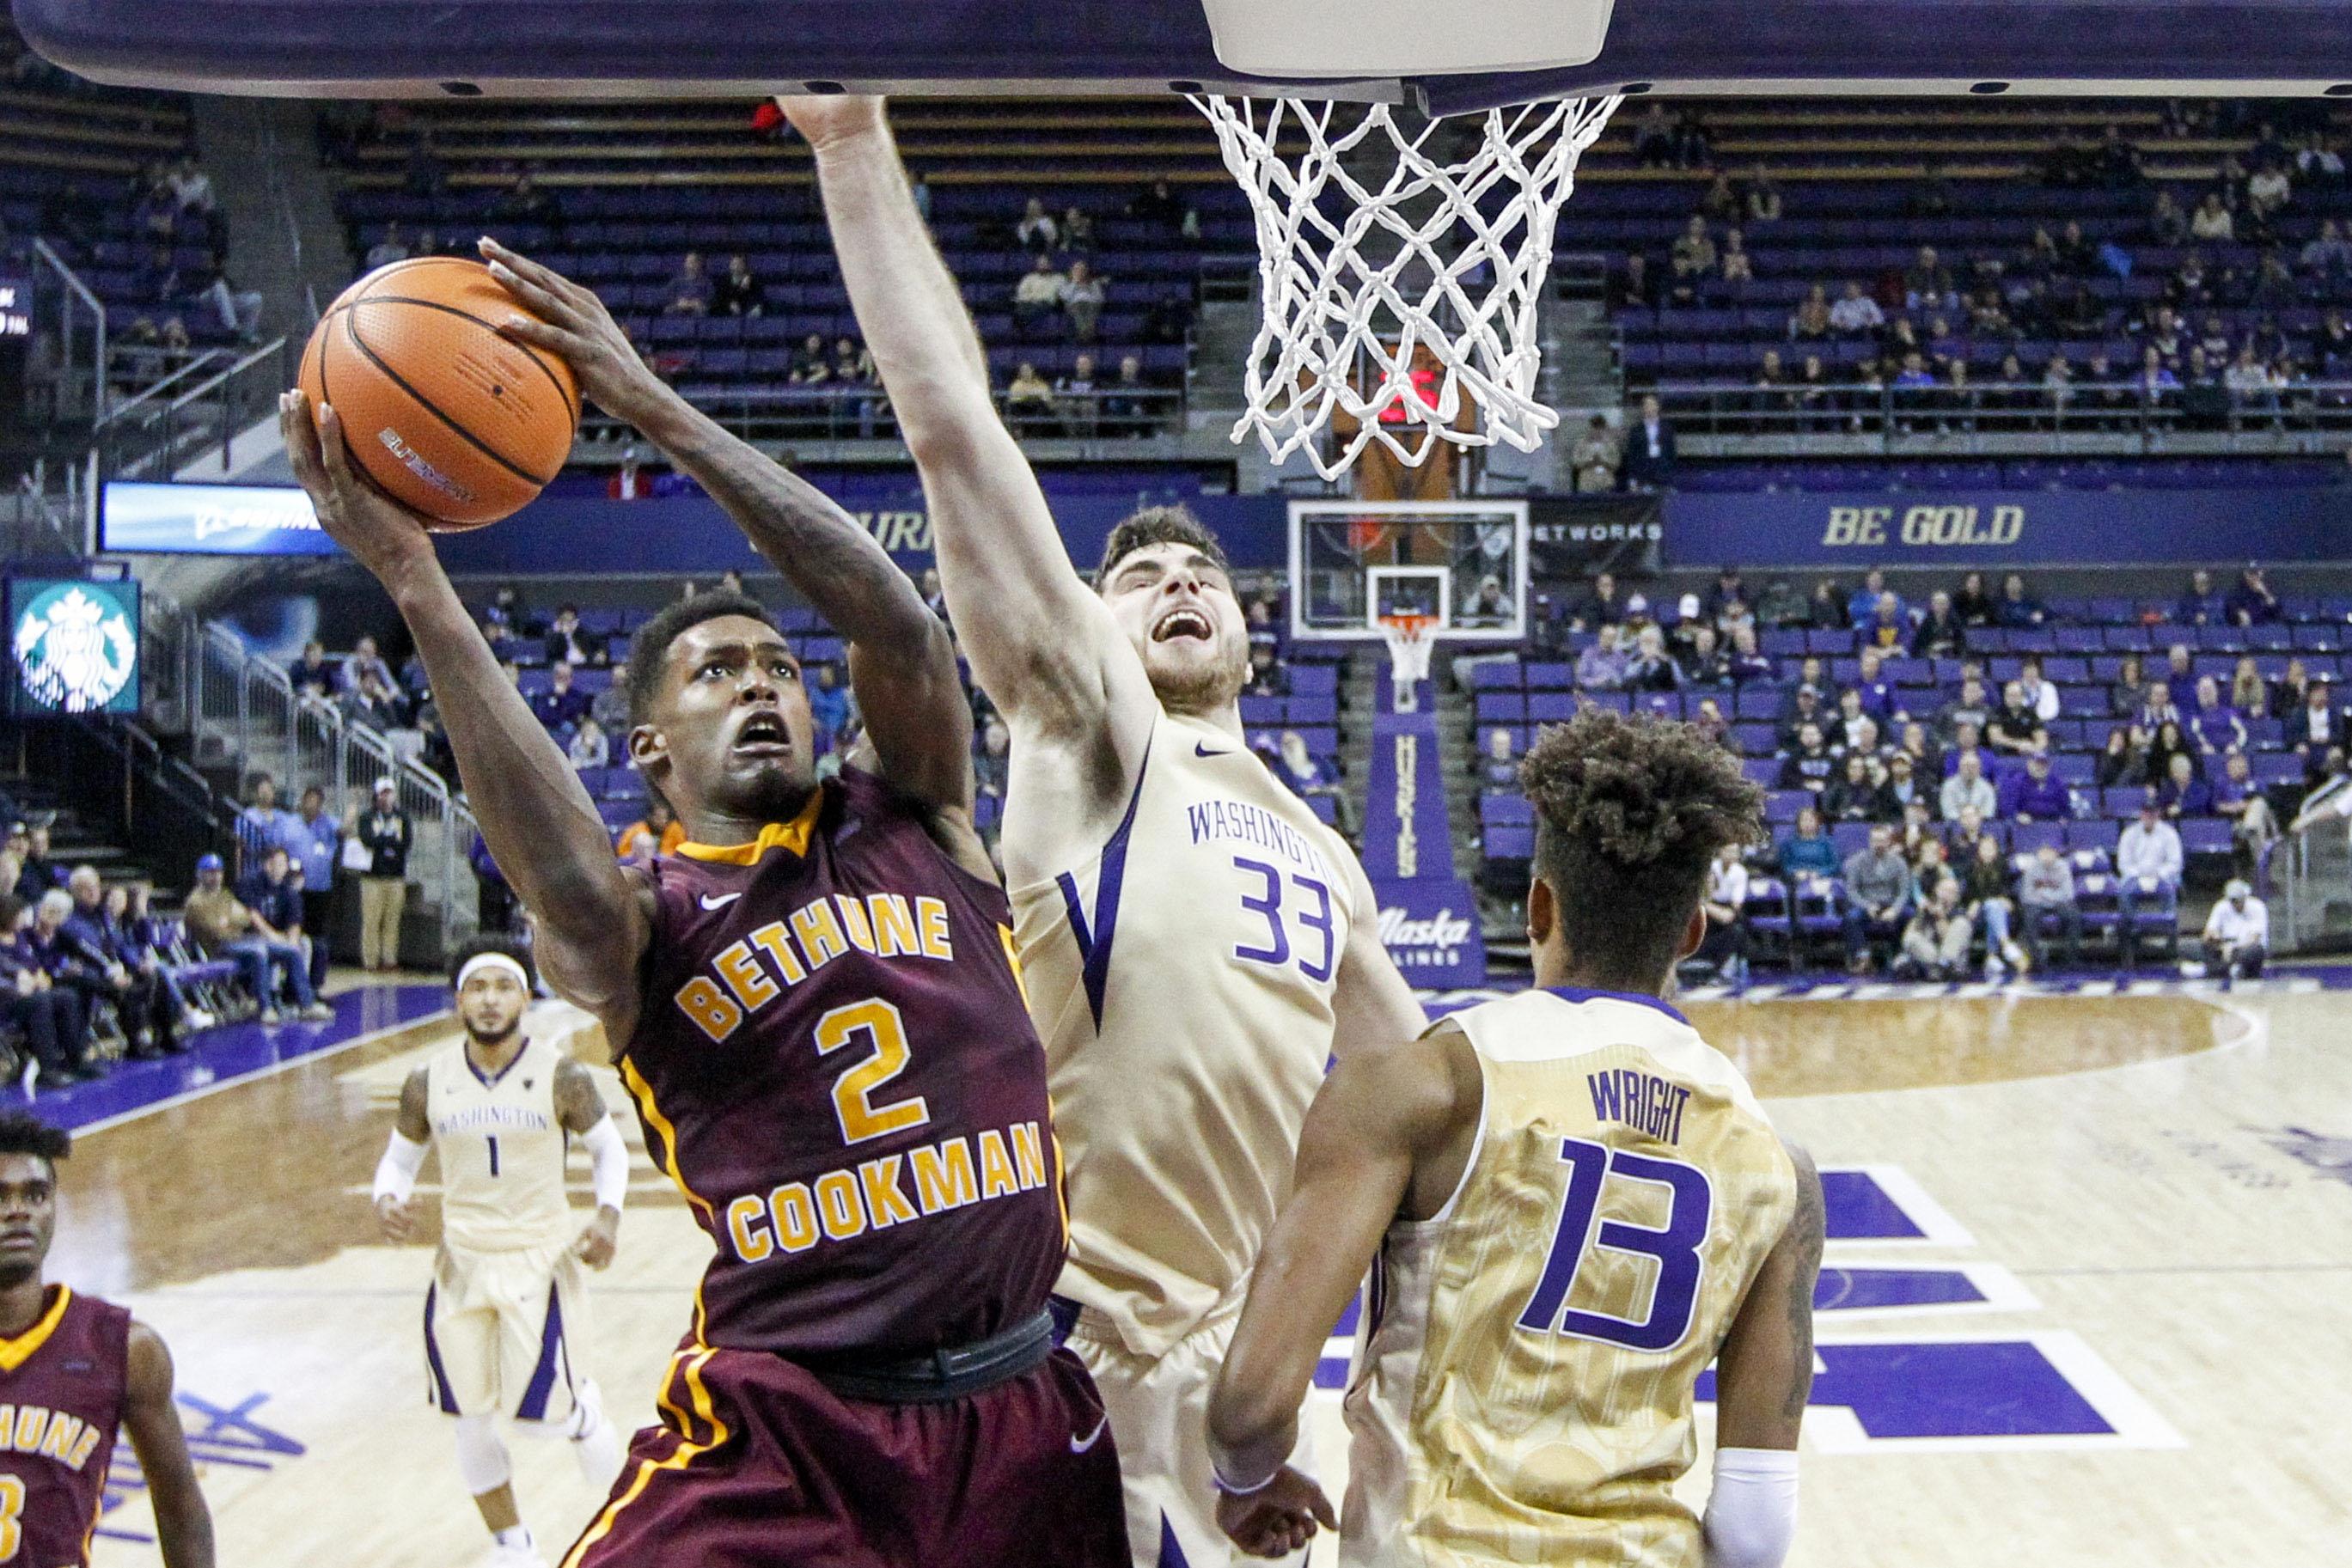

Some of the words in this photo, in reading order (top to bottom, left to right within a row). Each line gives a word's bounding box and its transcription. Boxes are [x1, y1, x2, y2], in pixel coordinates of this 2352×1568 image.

[1527, 523, 1663, 542] ETWORKS
[1822, 506, 1892, 546] BE
[1901, 504, 2025, 546] GOLD
[1187, 800, 1335, 888] WASHINGT
[1396, 735, 1417, 878] HUSKIES
[1231, 855, 1335, 983] 33
[1391, 949, 1459, 967] LINES
[674, 893, 954, 1044] BETHUNE
[814, 997, 931, 1146] 2
[1587, 1068, 1691, 1146] WRIGHT
[437, 1104, 549, 1135] WASHINGTON
[484, 1134, 500, 1178] 1
[726, 1121, 1047, 1264] COOKMAN
[1514, 1135, 1714, 1353] 13
